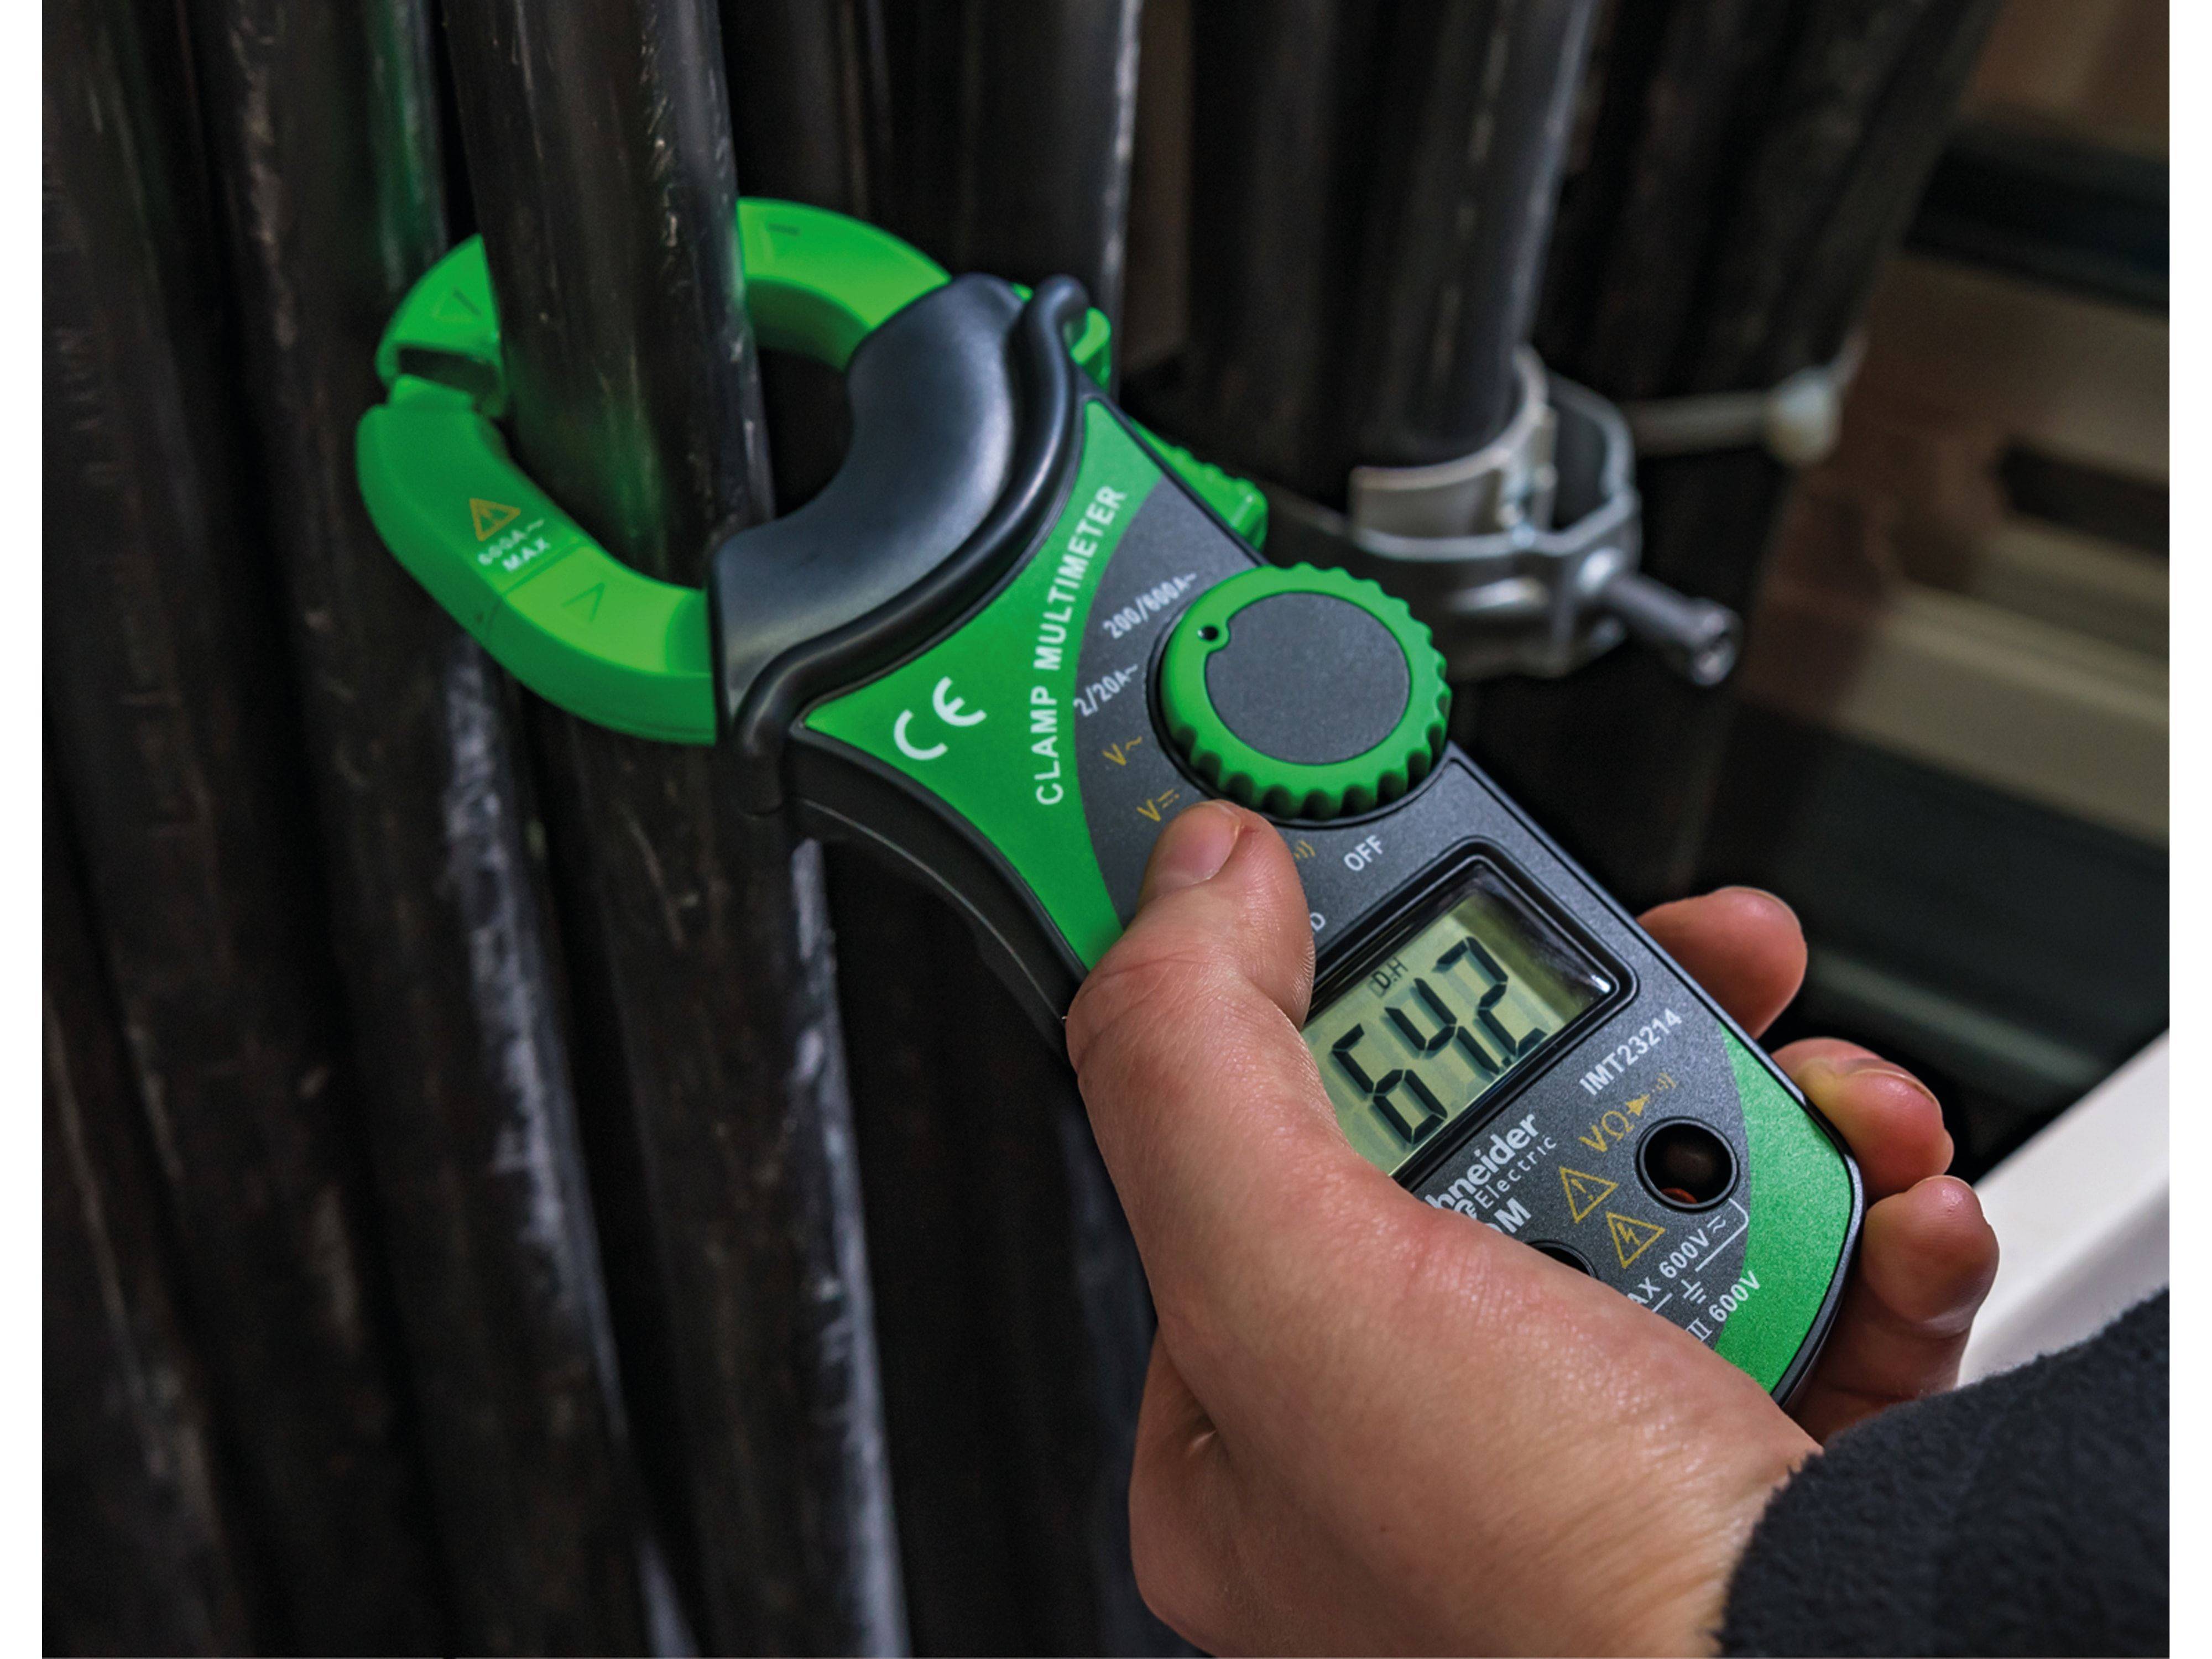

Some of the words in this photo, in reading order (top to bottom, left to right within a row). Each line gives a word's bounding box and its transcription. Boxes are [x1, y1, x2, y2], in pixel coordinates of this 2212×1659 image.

[502, 537, 551, 572] MAX
[1034, 486, 1128, 670] MULTIMETER
[894, 676, 987, 761] CE
[1030, 685, 1064, 806] CLAMP
[1344, 835, 1383, 872] OFF
[1579, 1008, 1682, 1095] IMT23214
[1473, 1136, 1557, 1209] Electric
[1659, 1228, 1709, 1279] 600V
[1709, 1269, 1760, 1322] 600V
